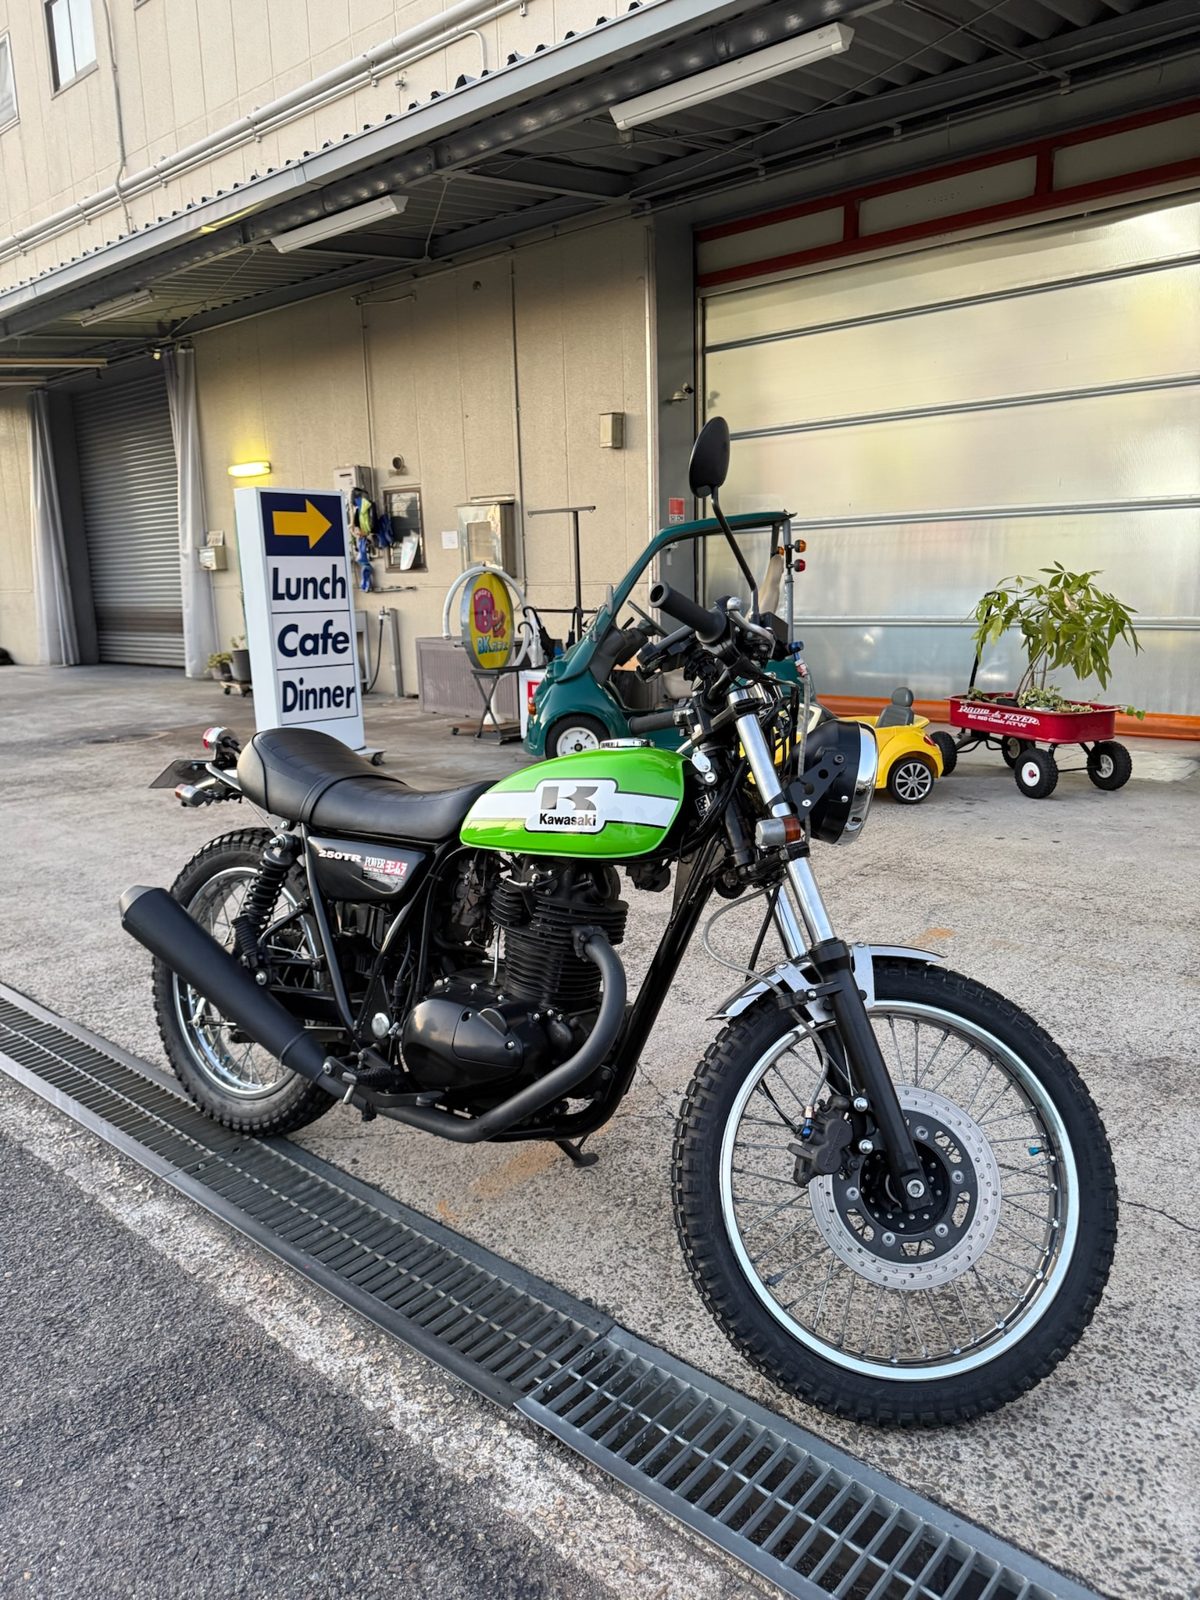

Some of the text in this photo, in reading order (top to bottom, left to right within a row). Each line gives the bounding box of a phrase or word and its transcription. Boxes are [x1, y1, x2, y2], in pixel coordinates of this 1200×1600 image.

[272, 564, 347, 601] Lunch
[277, 619, 350, 658] Cafe
[282, 678, 355, 713] Dinner
[539, 813, 597, 827] Kawasaki
[318, 849, 362, 863] 250TR
